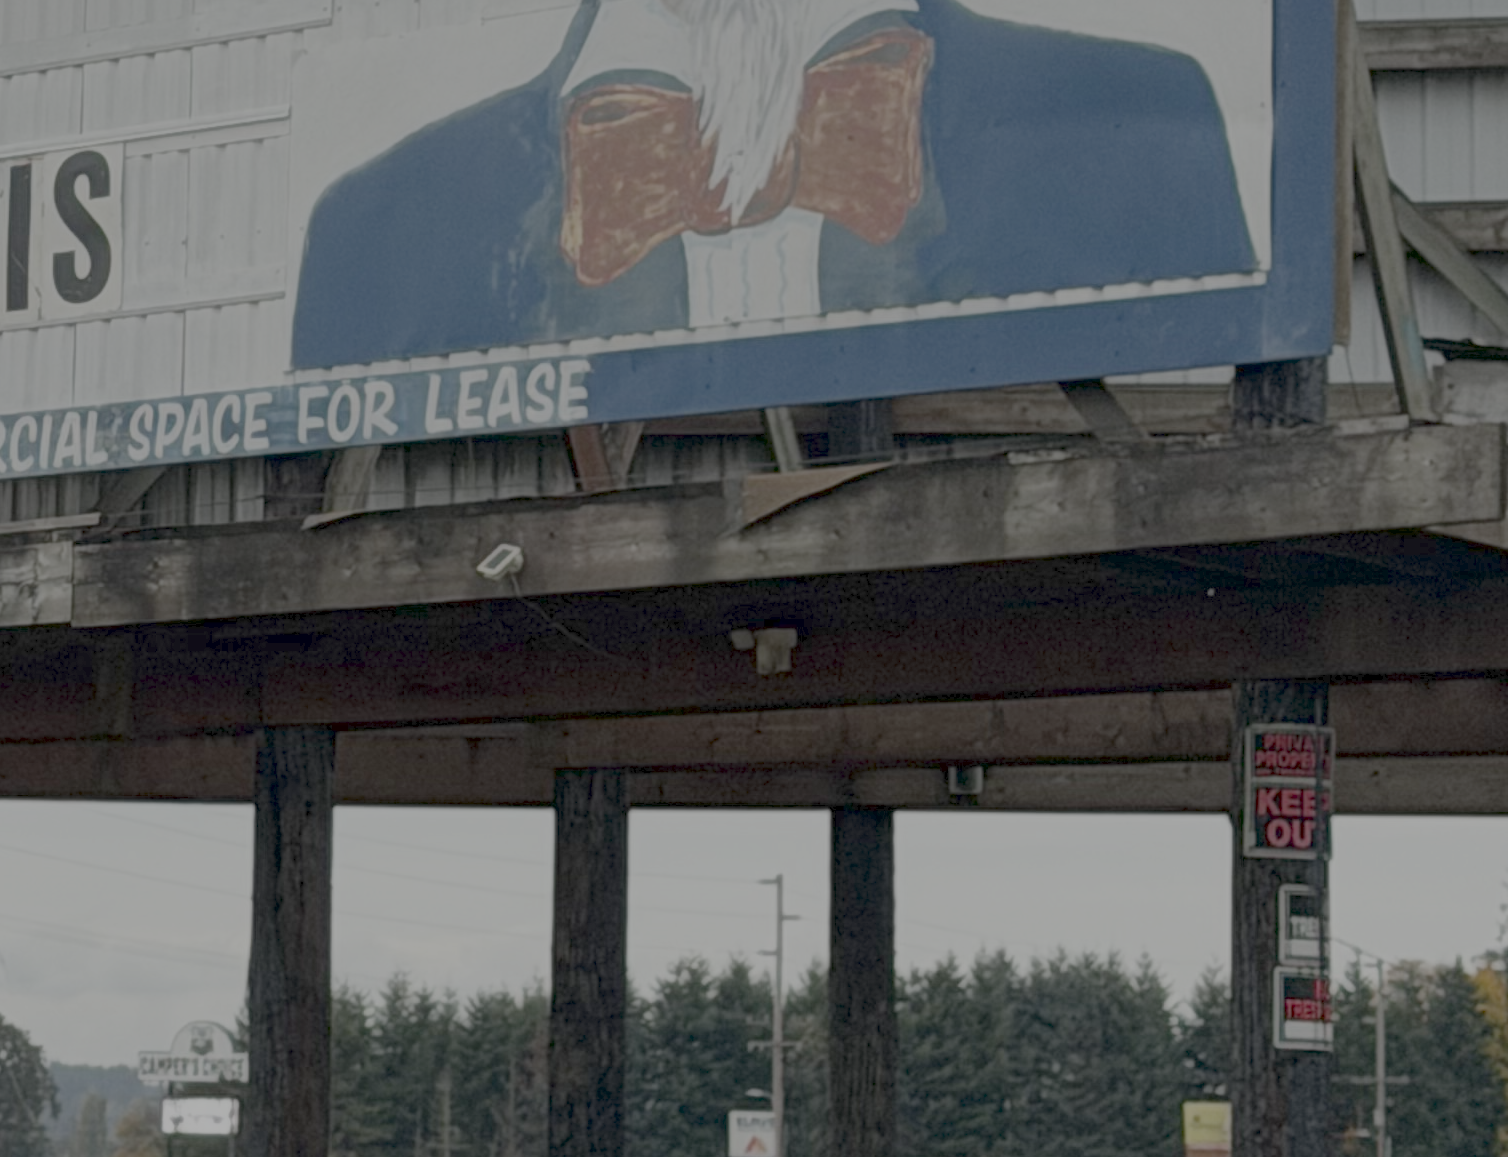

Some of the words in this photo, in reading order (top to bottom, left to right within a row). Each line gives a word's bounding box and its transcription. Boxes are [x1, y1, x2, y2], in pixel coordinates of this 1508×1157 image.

[128, 391, 273, 463] SPACE
[297, 379, 399, 444] FOR
[424, 359, 592, 435] LEASE
